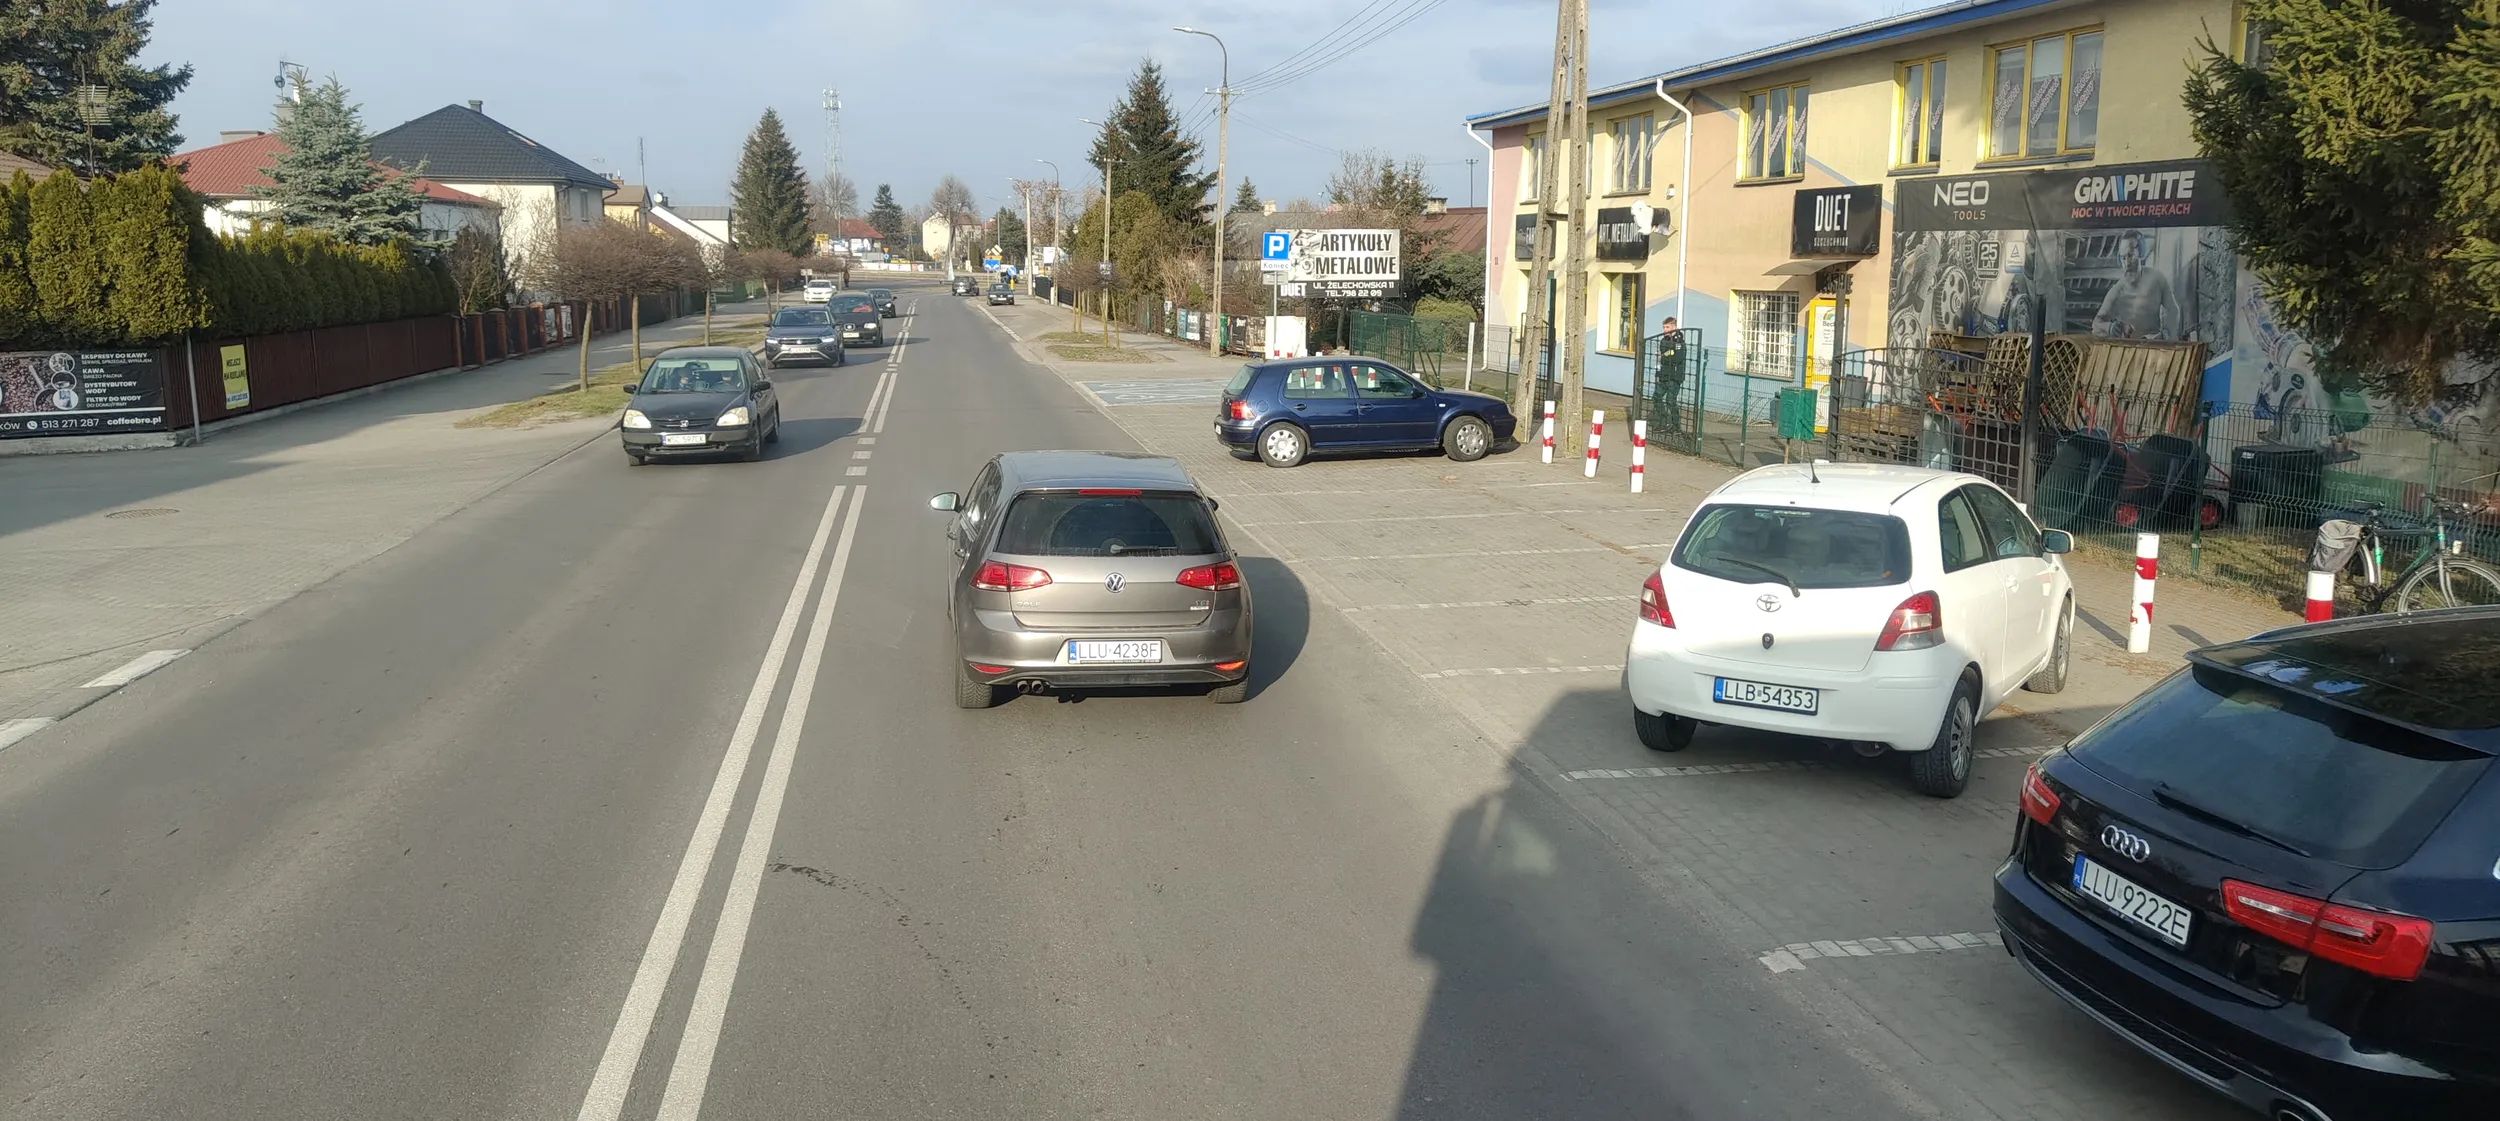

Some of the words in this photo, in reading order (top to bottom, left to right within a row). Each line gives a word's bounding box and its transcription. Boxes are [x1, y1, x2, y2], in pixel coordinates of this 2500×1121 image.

[1934, 180, 1990, 207] NEO
[2074, 170, 2196, 204] GRAPHITE
[1814, 193, 1851, 232] DUET
[1953, 210, 1986, 221] TOOLS
[2071, 207, 2093, 219] MOC
[2095, 206, 2105, 218] W
[2107, 204, 2147, 217] TWOICH
[2148, 203, 2191, 218] RĘKACH
[1268, 235, 1285, 257] P
[1320, 233, 1392, 252] ARTYKUŁY
[1980, 243, 1998, 260] 25
[1315, 256, 1397, 275] METALOWE
[1982, 260, 1996, 268] LAT
[1280, 283, 1307, 297] DUET
[1312, 281, 1326, 289] UL.
[1327, 280, 1388, 289] ŻELECHOWSKA
[1388, 281, 1395, 289] 11
[1358, 289, 1369, 297] 22
[42, 421, 59, 429] 513
[62, 420, 78, 428] 271
[80, 418, 100, 427] 287
[106, 416, 162, 426] coffeebro.pl
[1078, 644, 1108, 659] LLU
[1113, 643, 1159, 659] 4238F
[1724, 680, 1756, 701] LLB
[1761, 686, 1814, 709] 54353
[2082, 862, 2119, 902] LLU
[2121, 885, 2188, 941] 9222E
